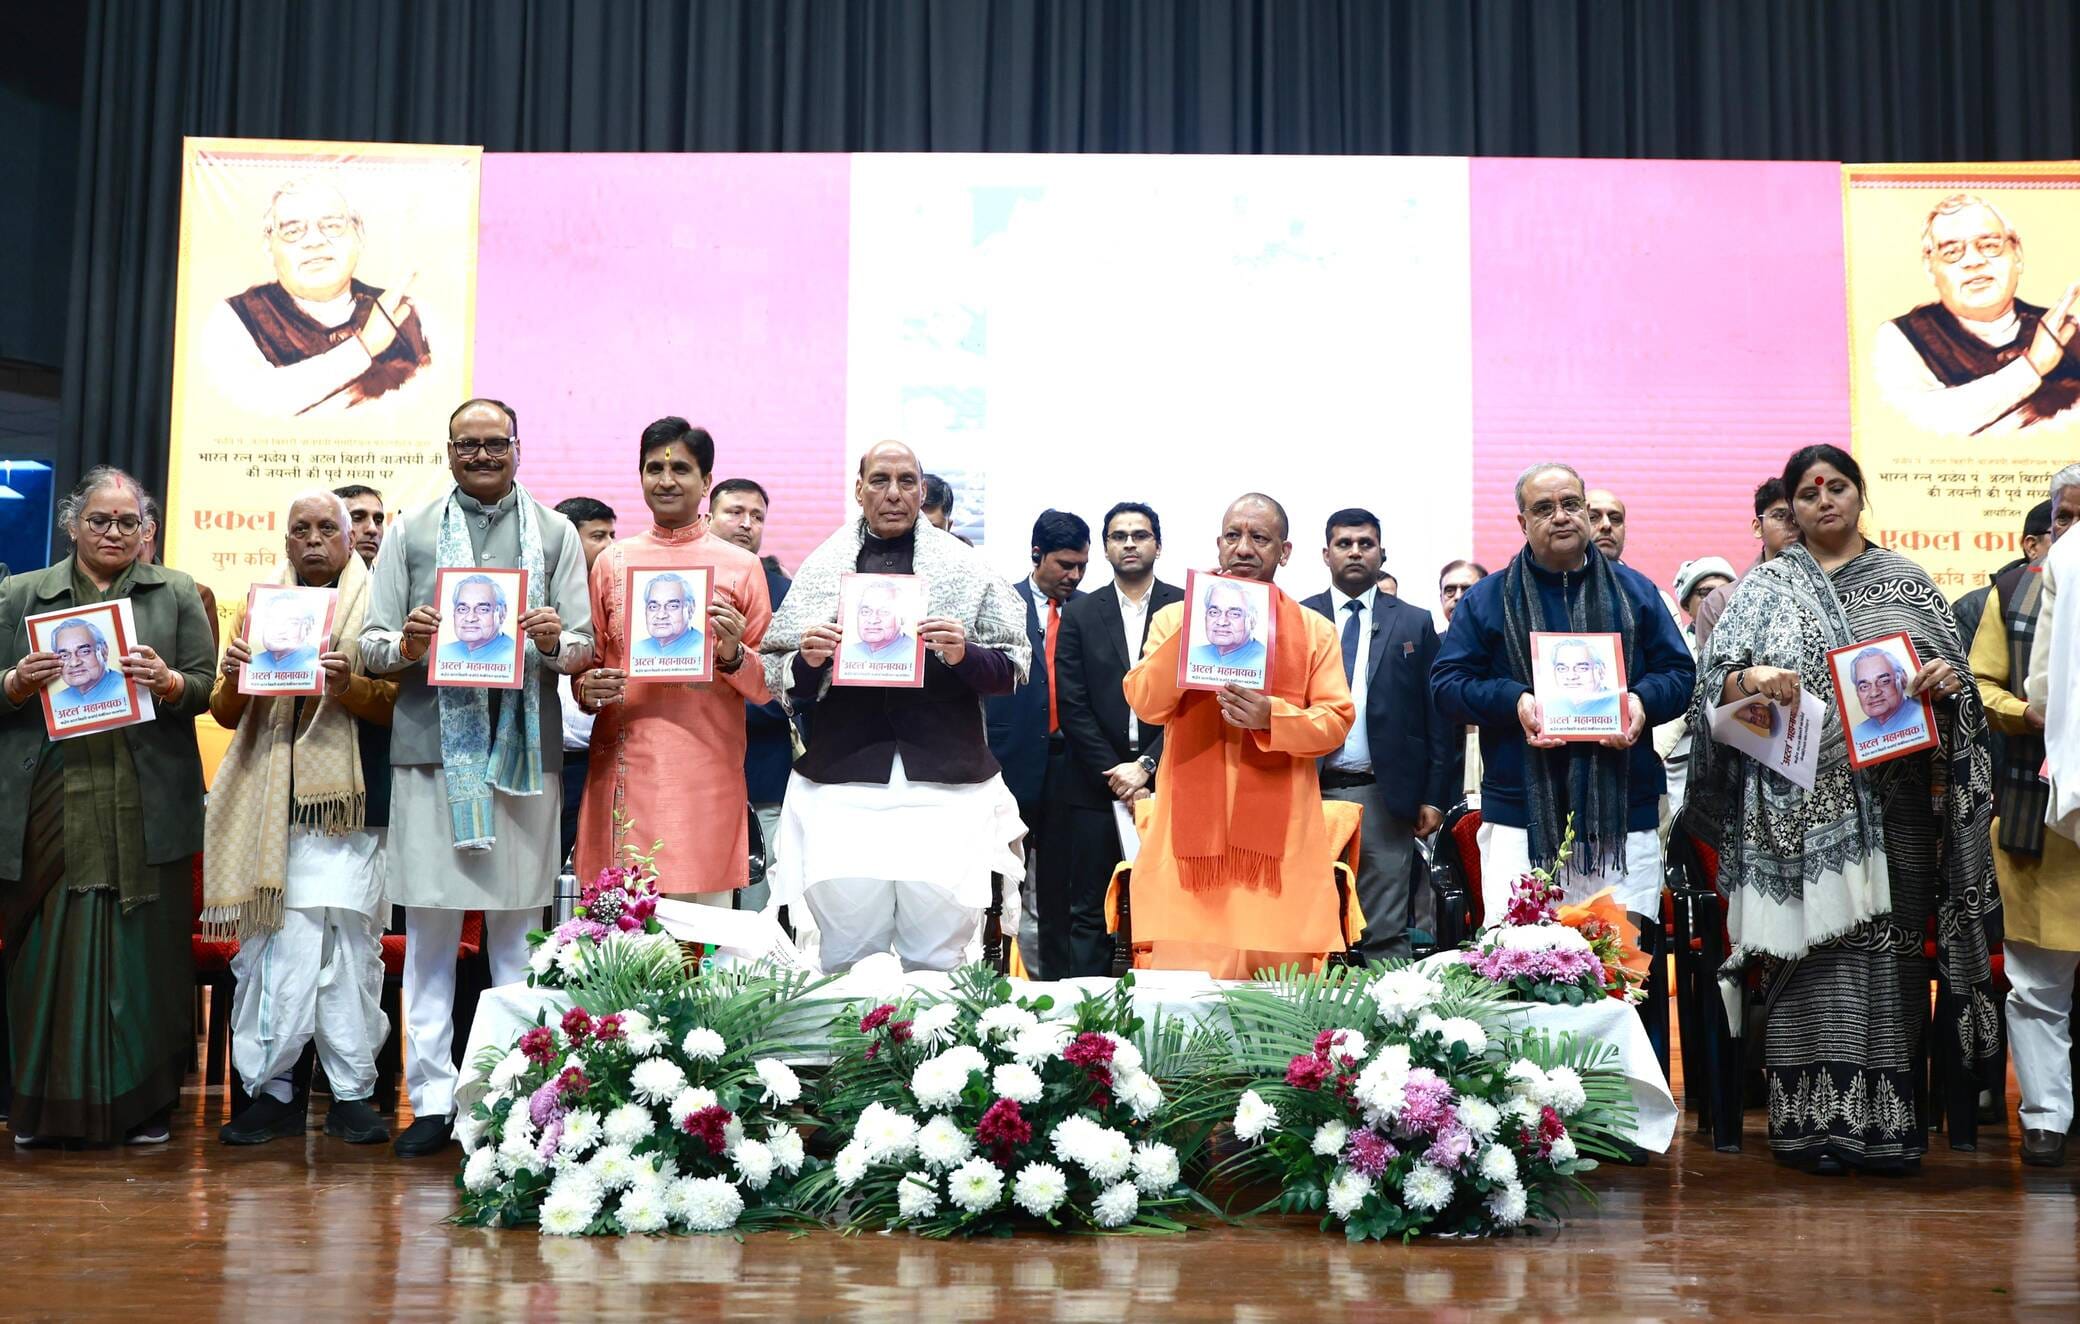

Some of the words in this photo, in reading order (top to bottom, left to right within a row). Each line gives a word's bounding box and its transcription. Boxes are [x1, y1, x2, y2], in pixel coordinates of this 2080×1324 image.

[199, 452, 228, 463] भारत
[233, 452, 252, 463] रत्न
[310, 454, 336, 465] अटल
[341, 451, 375, 465] बिहारी
[246, 465, 260, 478] की
[264, 465, 301, 478] जयन्ती
[306, 465, 320, 479] की
[325, 467, 342, 482] पूर्व
[380, 469, 394, 480] पर
[1879, 472, 1908, 482] भारत
[1927, 484, 1941, 497] की
[1987, 485, 2000, 498] की
[194, 510, 275, 531] एकल
[1880, 530, 1961, 552] एकल
[211, 552, 237, 571] युग
[244, 547, 277, 566] कवि
[1932, 568, 1965, 586] कवि
